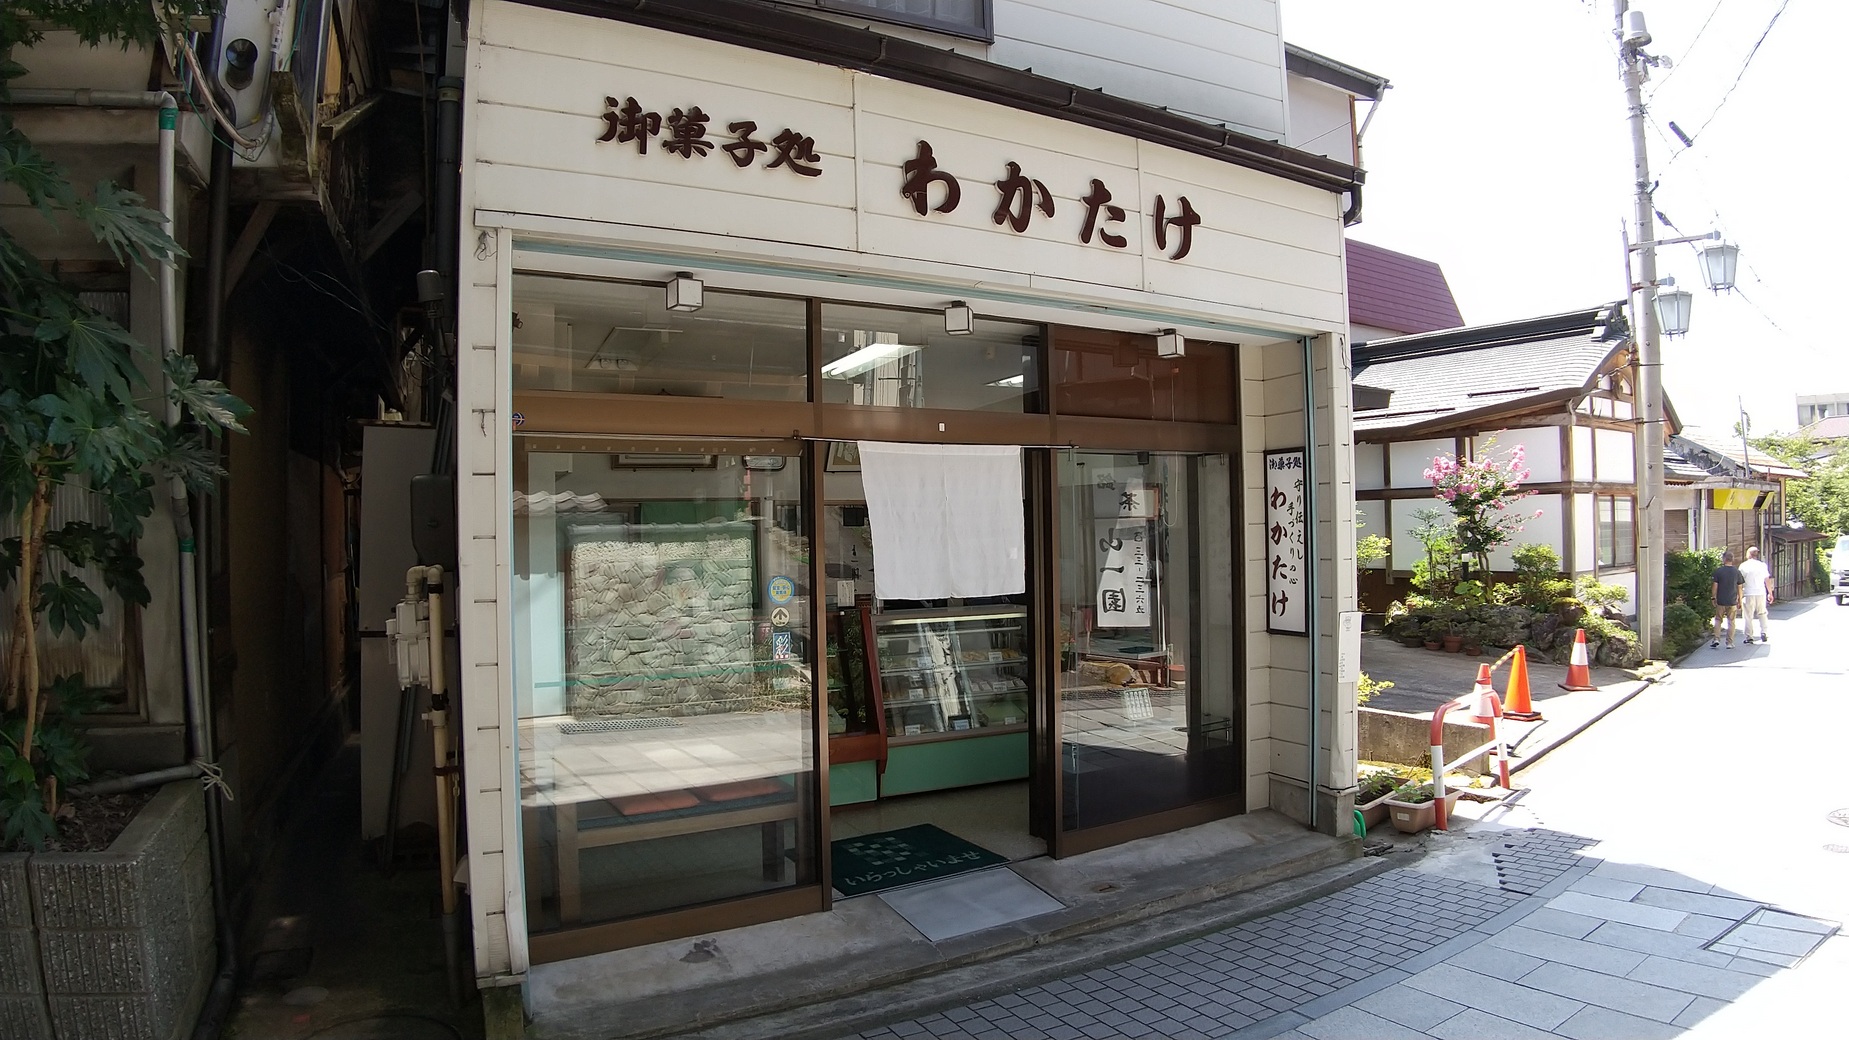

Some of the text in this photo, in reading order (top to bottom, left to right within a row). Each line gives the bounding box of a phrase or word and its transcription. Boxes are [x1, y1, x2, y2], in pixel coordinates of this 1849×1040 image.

[597, 97, 822, 178] 御菓子処
[902, 140, 1201, 260] わかたけ
[1269, 456, 1302, 470] 御菓子処
[1271, 487, 1288, 617] わかたけ
[1286, 502, 1298, 584] 手づくりの心
[844, 850, 981, 886] いらっしゃいませ
